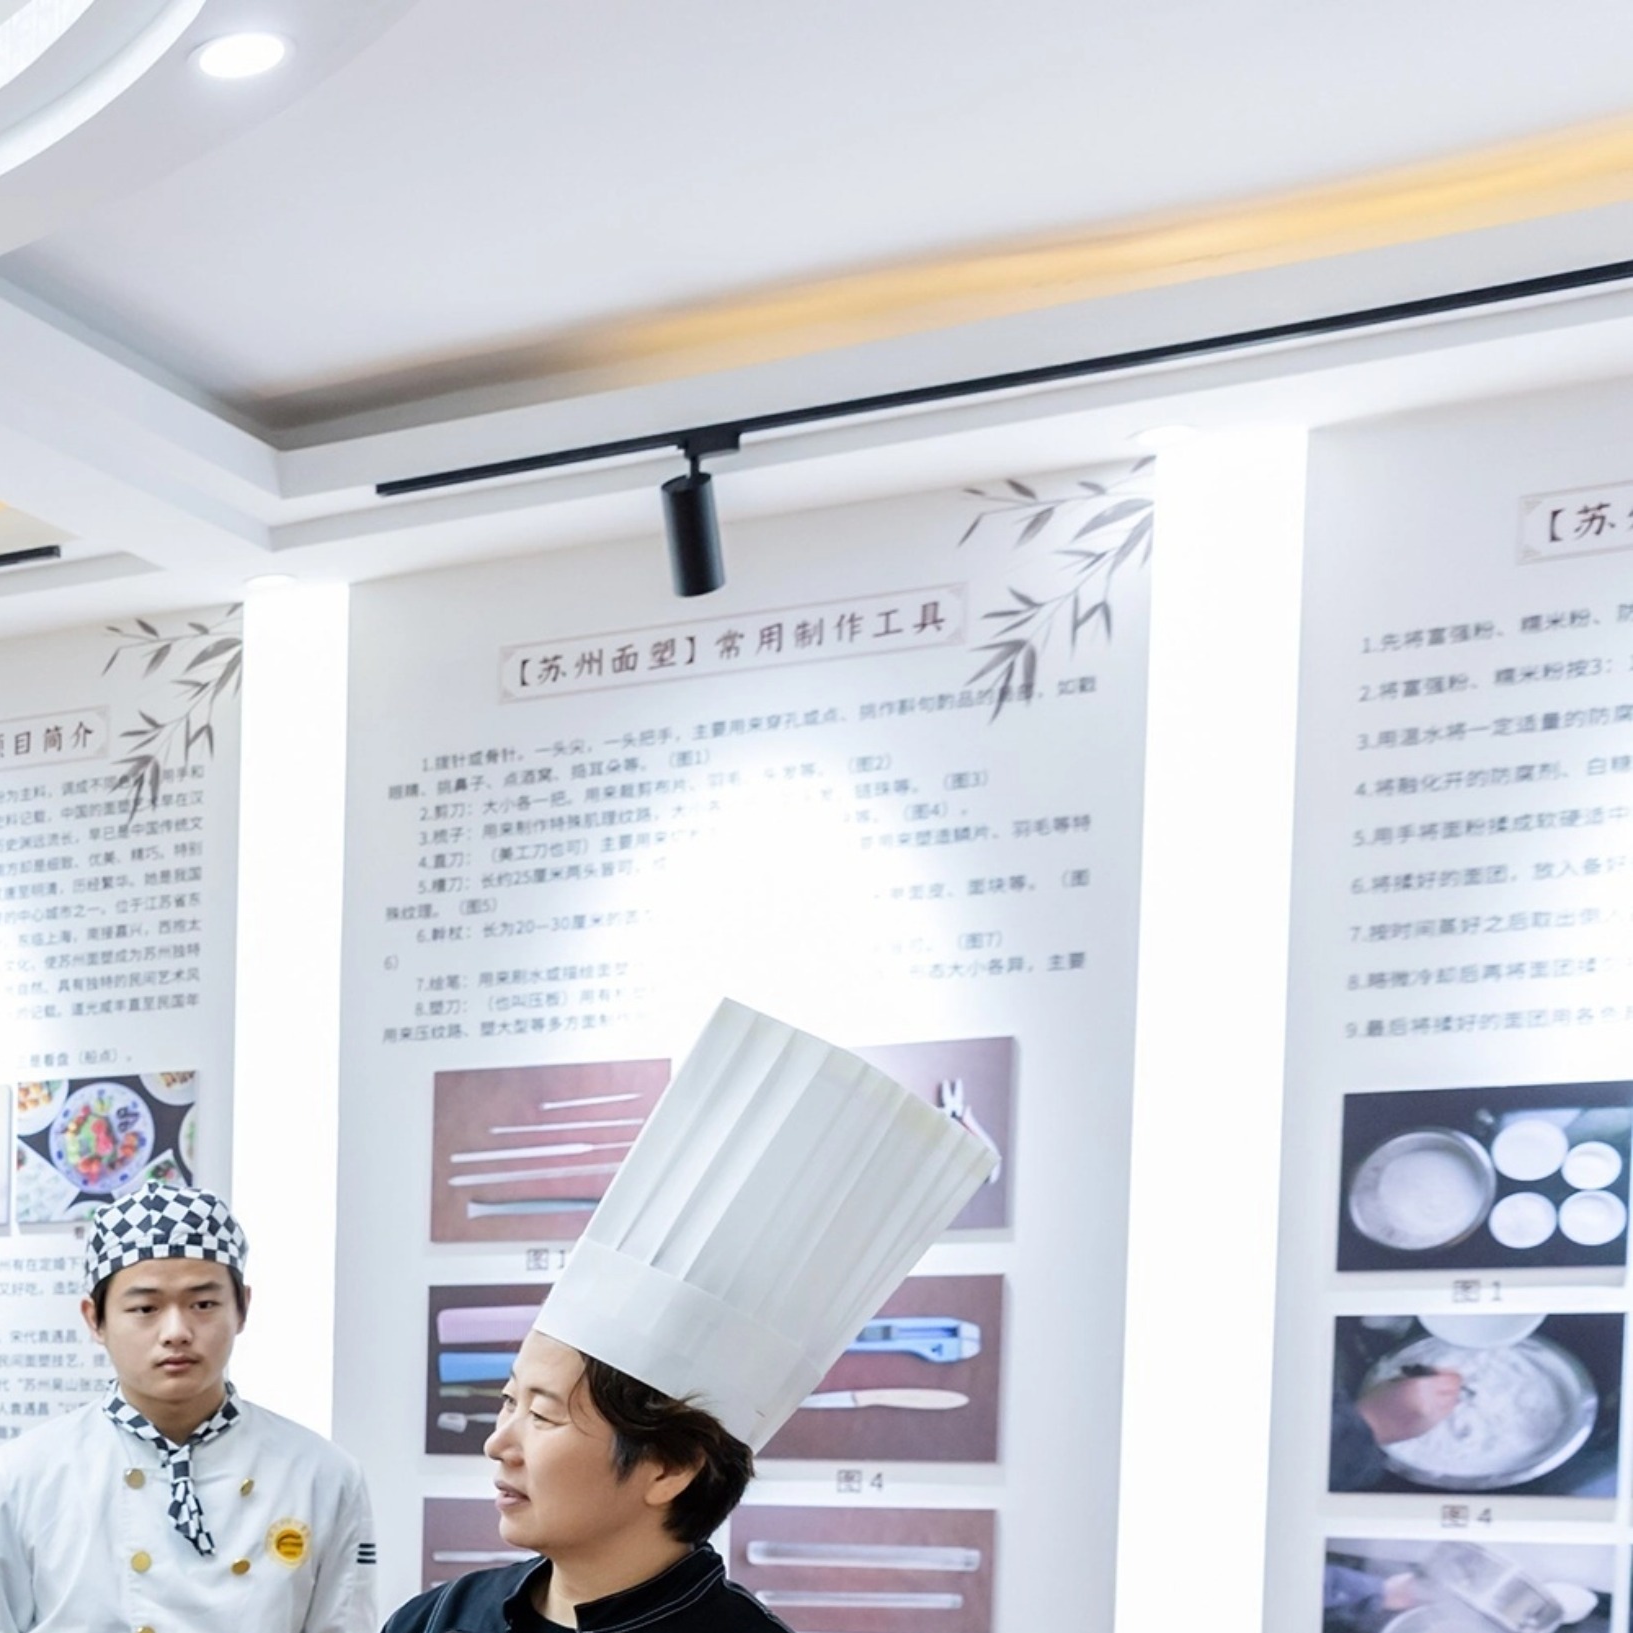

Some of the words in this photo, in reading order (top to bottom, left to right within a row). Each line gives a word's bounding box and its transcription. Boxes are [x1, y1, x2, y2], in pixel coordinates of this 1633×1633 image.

[1549, 501, 1633, 544] 【苏
[519, 600, 948, 689] 【苏州面塑】常用制作工具
